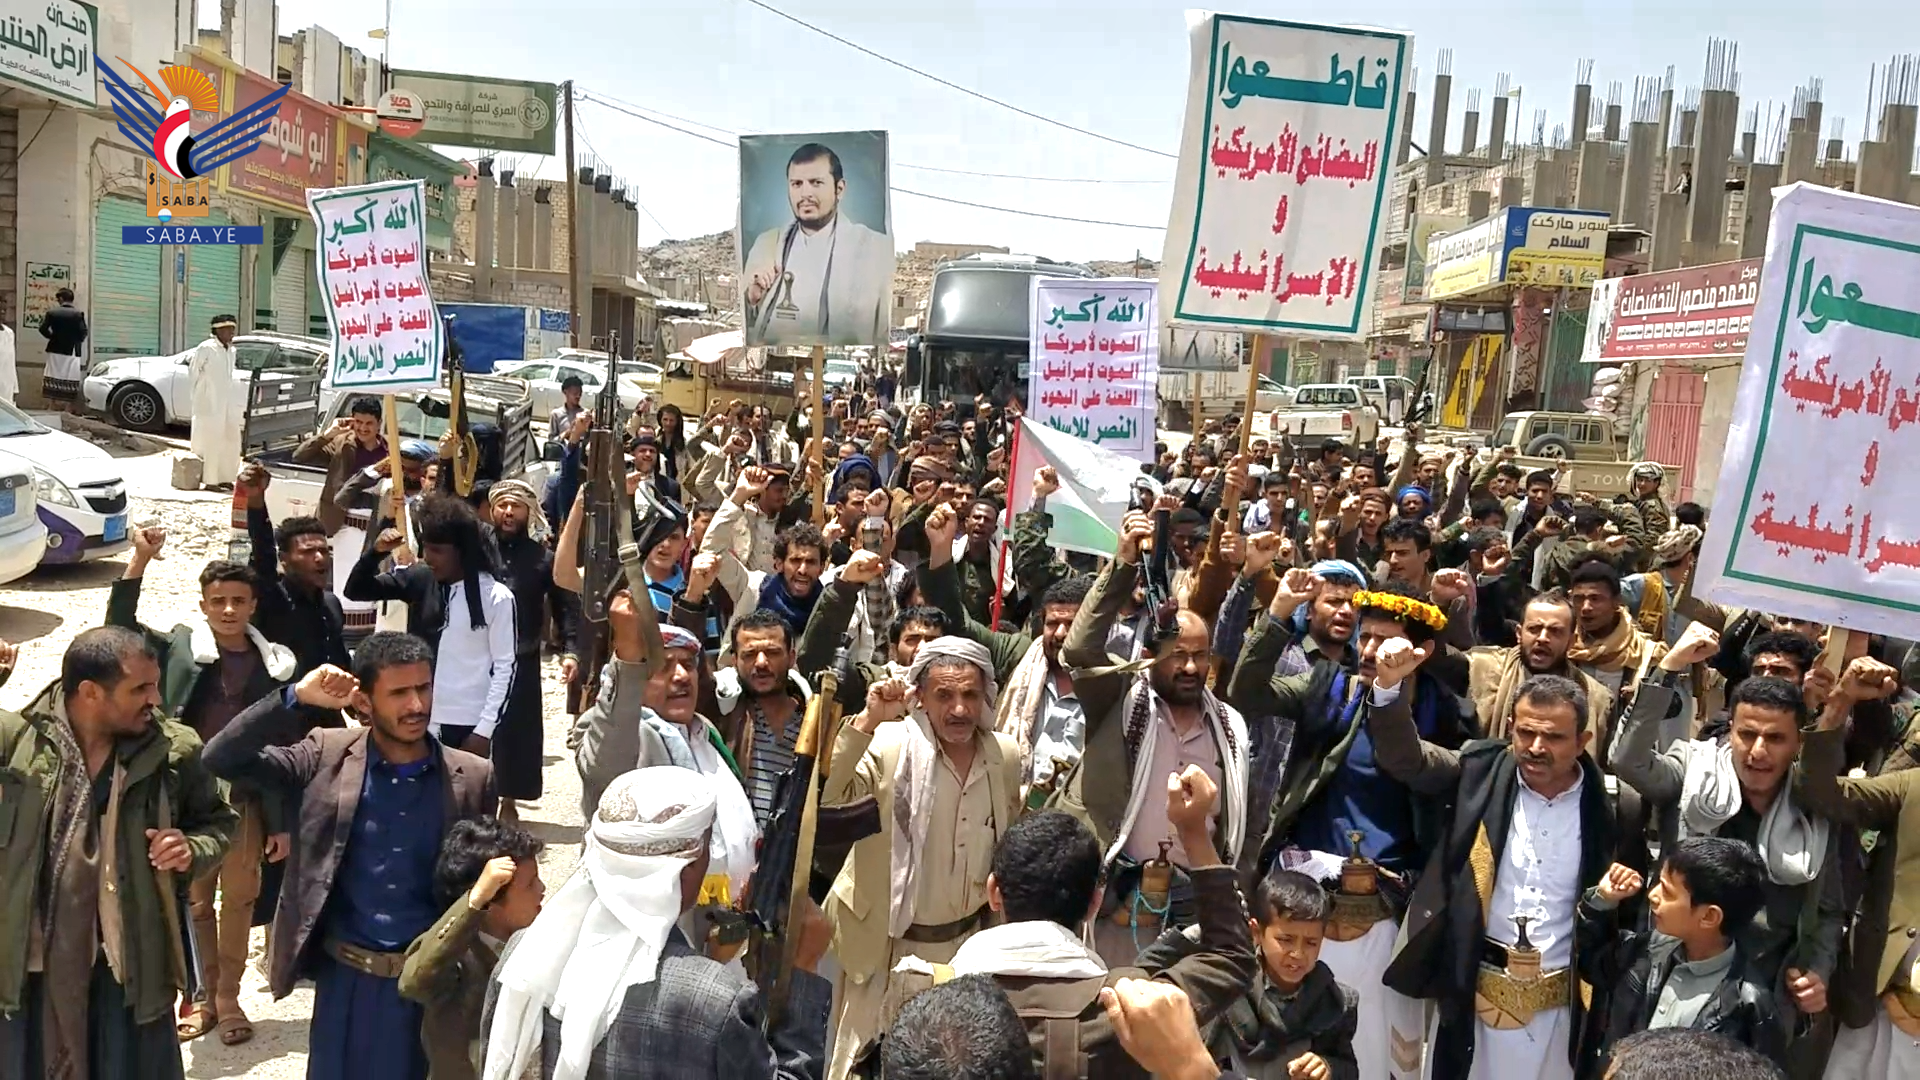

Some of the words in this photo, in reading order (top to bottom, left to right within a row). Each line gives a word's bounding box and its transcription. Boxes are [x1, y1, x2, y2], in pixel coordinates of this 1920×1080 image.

[0, 15, 47, 60] الجنتي
[50, 37, 88, 76] أرض
[1219, 41, 1388, 109] قاطعوا
[425, 99, 453, 112] والتحو
[455, 100, 490, 115] للصرافة
[478, 92, 498, 101] شركة
[308, 117, 329, 173] أبو
[1211, 122, 1298, 181] الأمريكية
[1297, 132, 1378, 188] البضائع
[326, 197, 378, 245] أكبر
[384, 197, 416, 230] الله
[1272, 194, 1288, 235] و
[1531, 215, 1573, 231] ماركت
[381, 241, 419, 270] الموت
[1548, 235, 1590, 249] السلام
[328, 241, 377, 273] لأمريكا
[1195, 246, 1357, 306] الإسرائيلية
[1741, 265, 1758, 280] مركز
[334, 279, 380, 308] لإسرائيل
[384, 277, 426, 303] الموت
[1620, 281, 1681, 321] للتخفيضات
[1678, 281, 1717, 317] منصور
[1717, 281, 1757, 308] محمد
[399, 309, 432, 331] اللعنة
[1044, 293, 1105, 329] أكبر
[1107, 296, 1144, 322] الله
[340, 313, 371, 341] اليهود
[374, 311, 393, 338] على
[389, 337, 432, 374] النصر
[1044, 330, 1096, 355] لأمريكا
[1098, 334, 1141, 355] الموت
[338, 343, 384, 378] للإسلام
[1043, 360, 1094, 383] لإسرائيل
[1097, 362, 1139, 382] الموت
[1041, 389, 1078, 408] اليهود
[1105, 389, 1137, 407] اللعنة
[1782, 348, 1892, 420] الأمريكية
[1082, 391, 1101, 410] على
[1092, 415, 1137, 445] النصر
[1860, 440, 1880, 488] و
[1592, 474, 1625, 486] TOY
